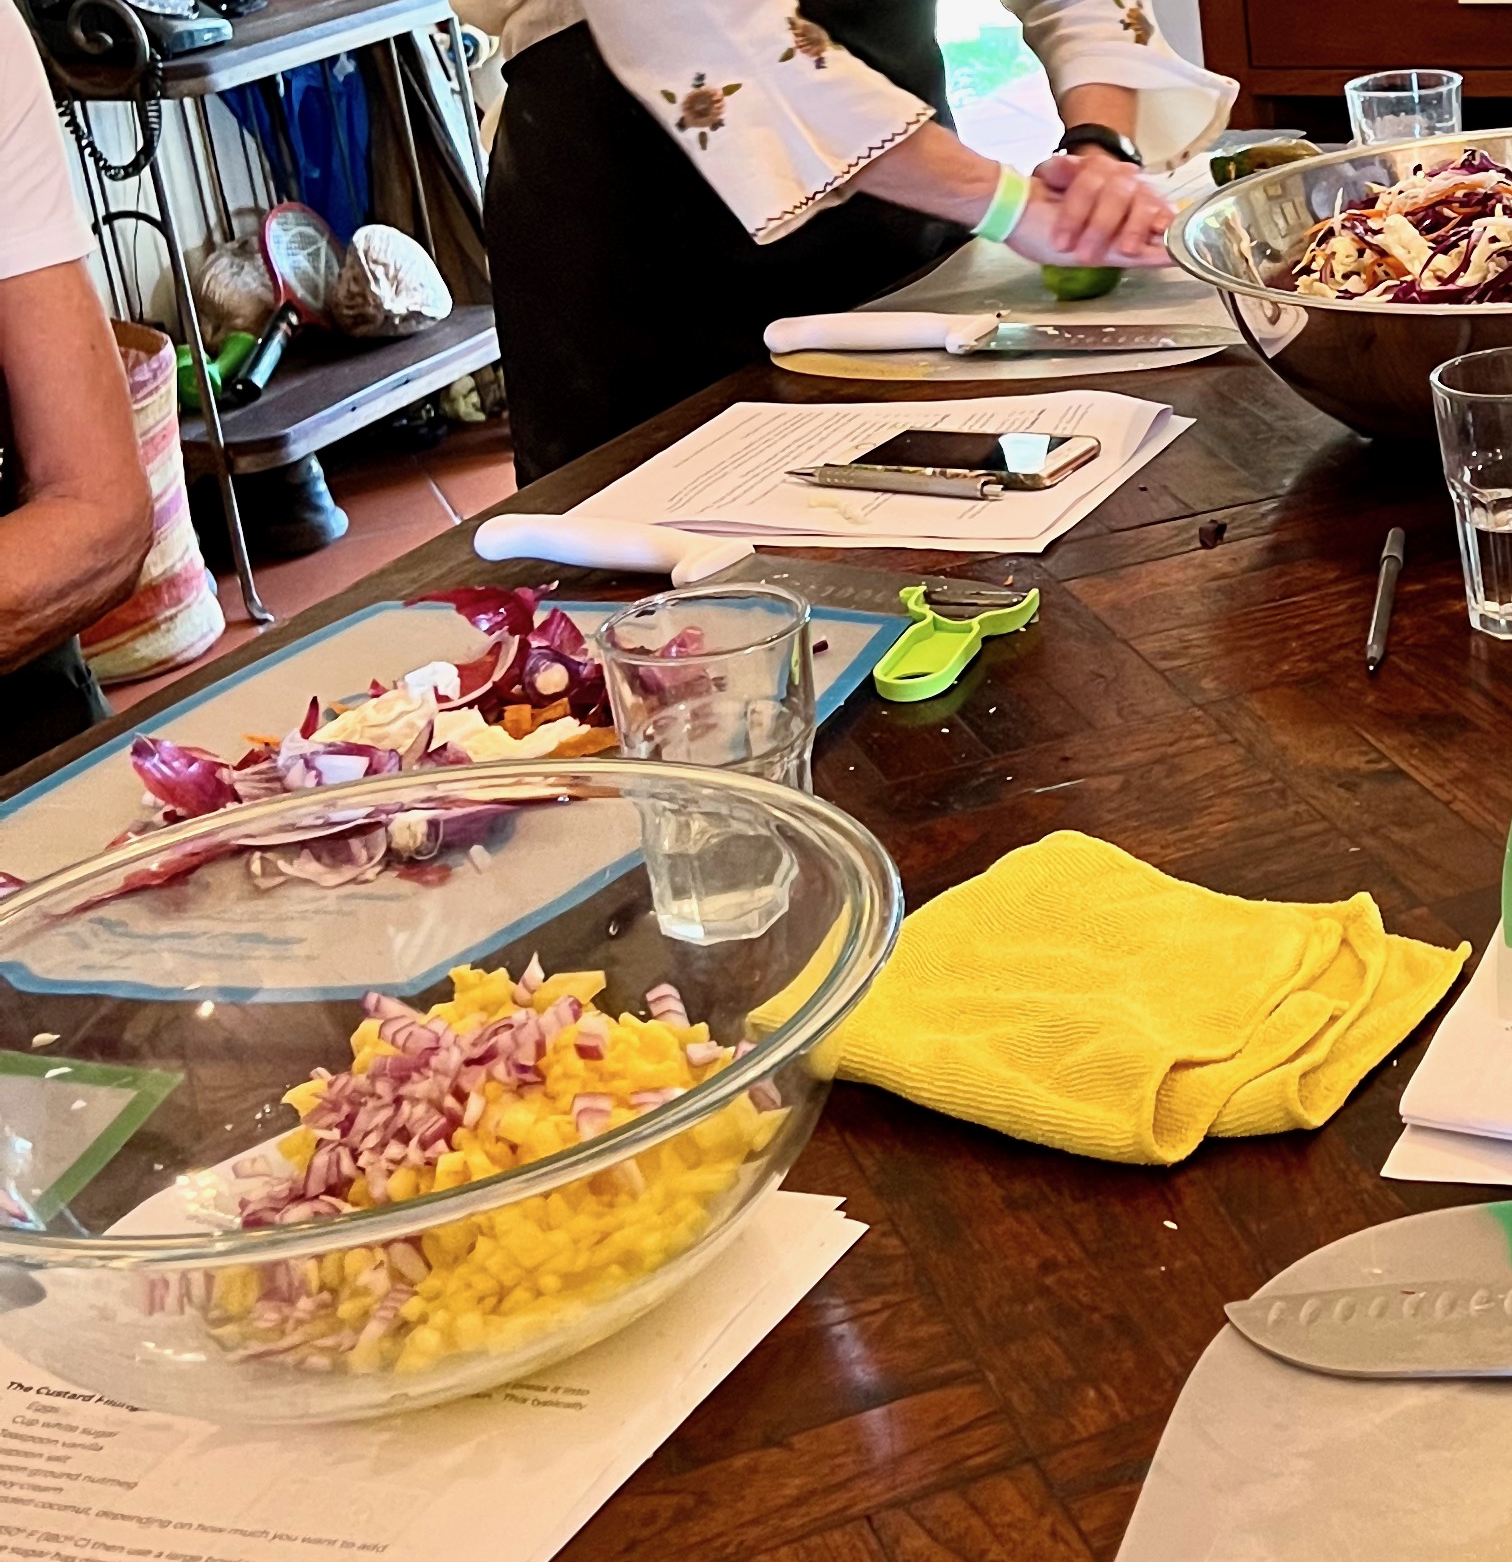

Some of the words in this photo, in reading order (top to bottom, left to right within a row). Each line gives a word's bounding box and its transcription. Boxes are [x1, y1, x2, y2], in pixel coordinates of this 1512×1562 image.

[6, 1381, 34, 1393] The
[36, 1386, 96, 1403] Custard
[12, 1415, 39, 1427] Cup
[80, 1427, 120, 1440] sugar
[95, 1510, 173, 1529] depending
[173, 1521, 193, 1530] on
